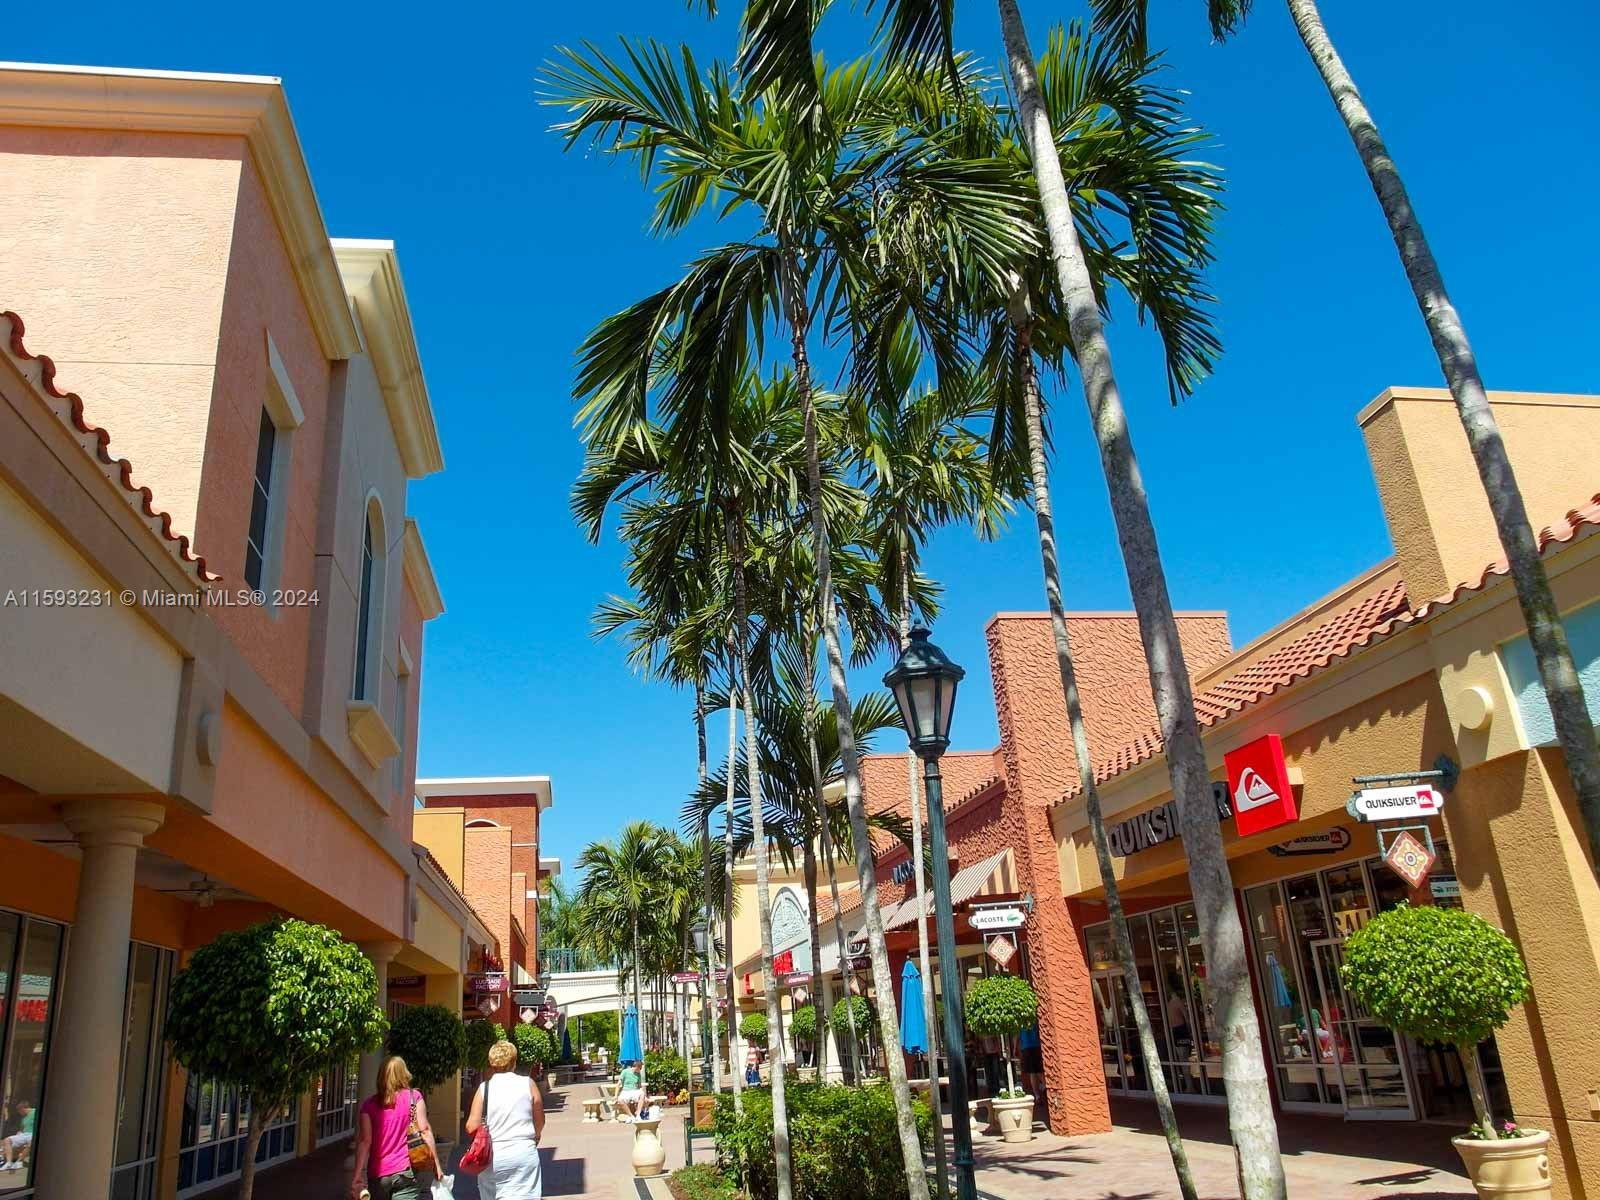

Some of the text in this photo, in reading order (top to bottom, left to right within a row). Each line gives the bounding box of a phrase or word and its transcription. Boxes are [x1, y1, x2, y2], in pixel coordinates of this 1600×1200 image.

[1365, 796, 1417, 809] QUIKSILVER
[1107, 781, 1233, 858] QUIKSILR
[976, 916, 1004, 924] LACOSTE
